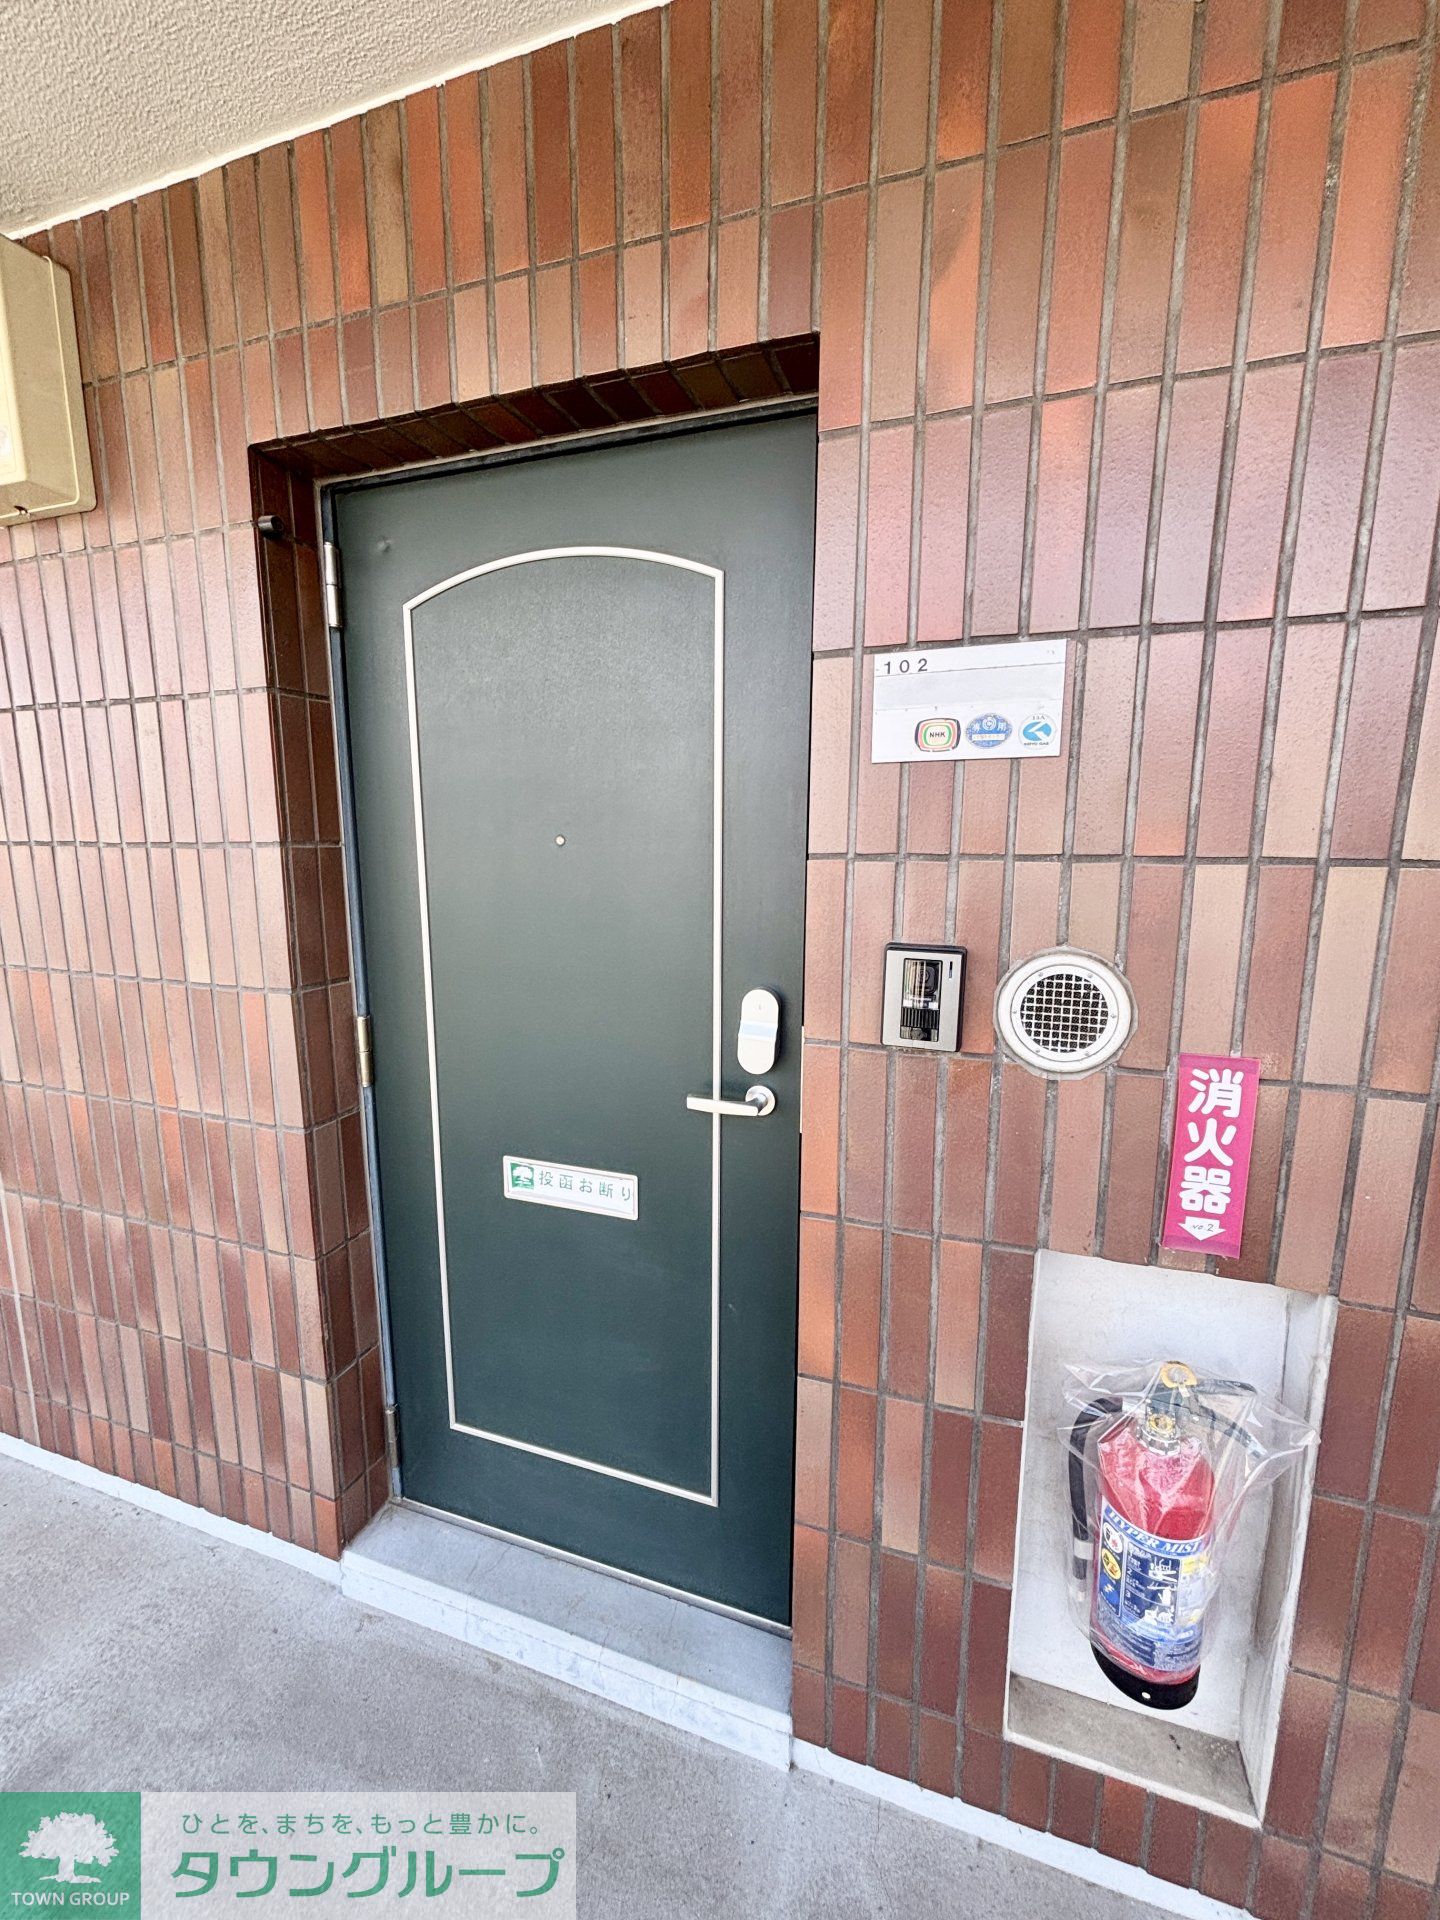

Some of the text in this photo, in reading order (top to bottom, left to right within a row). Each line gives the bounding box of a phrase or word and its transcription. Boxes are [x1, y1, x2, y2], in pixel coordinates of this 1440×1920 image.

[884, 658, 928, 675] 102
[929, 731, 946, 739] NHK
[1178, 1068, 1245, 1216] 消火器
[538, 1170, 632, 1202] 投函お断り
[1108, 1511, 1160, 1549] HYPER
[1161, 1539, 1201, 1553] MIST
